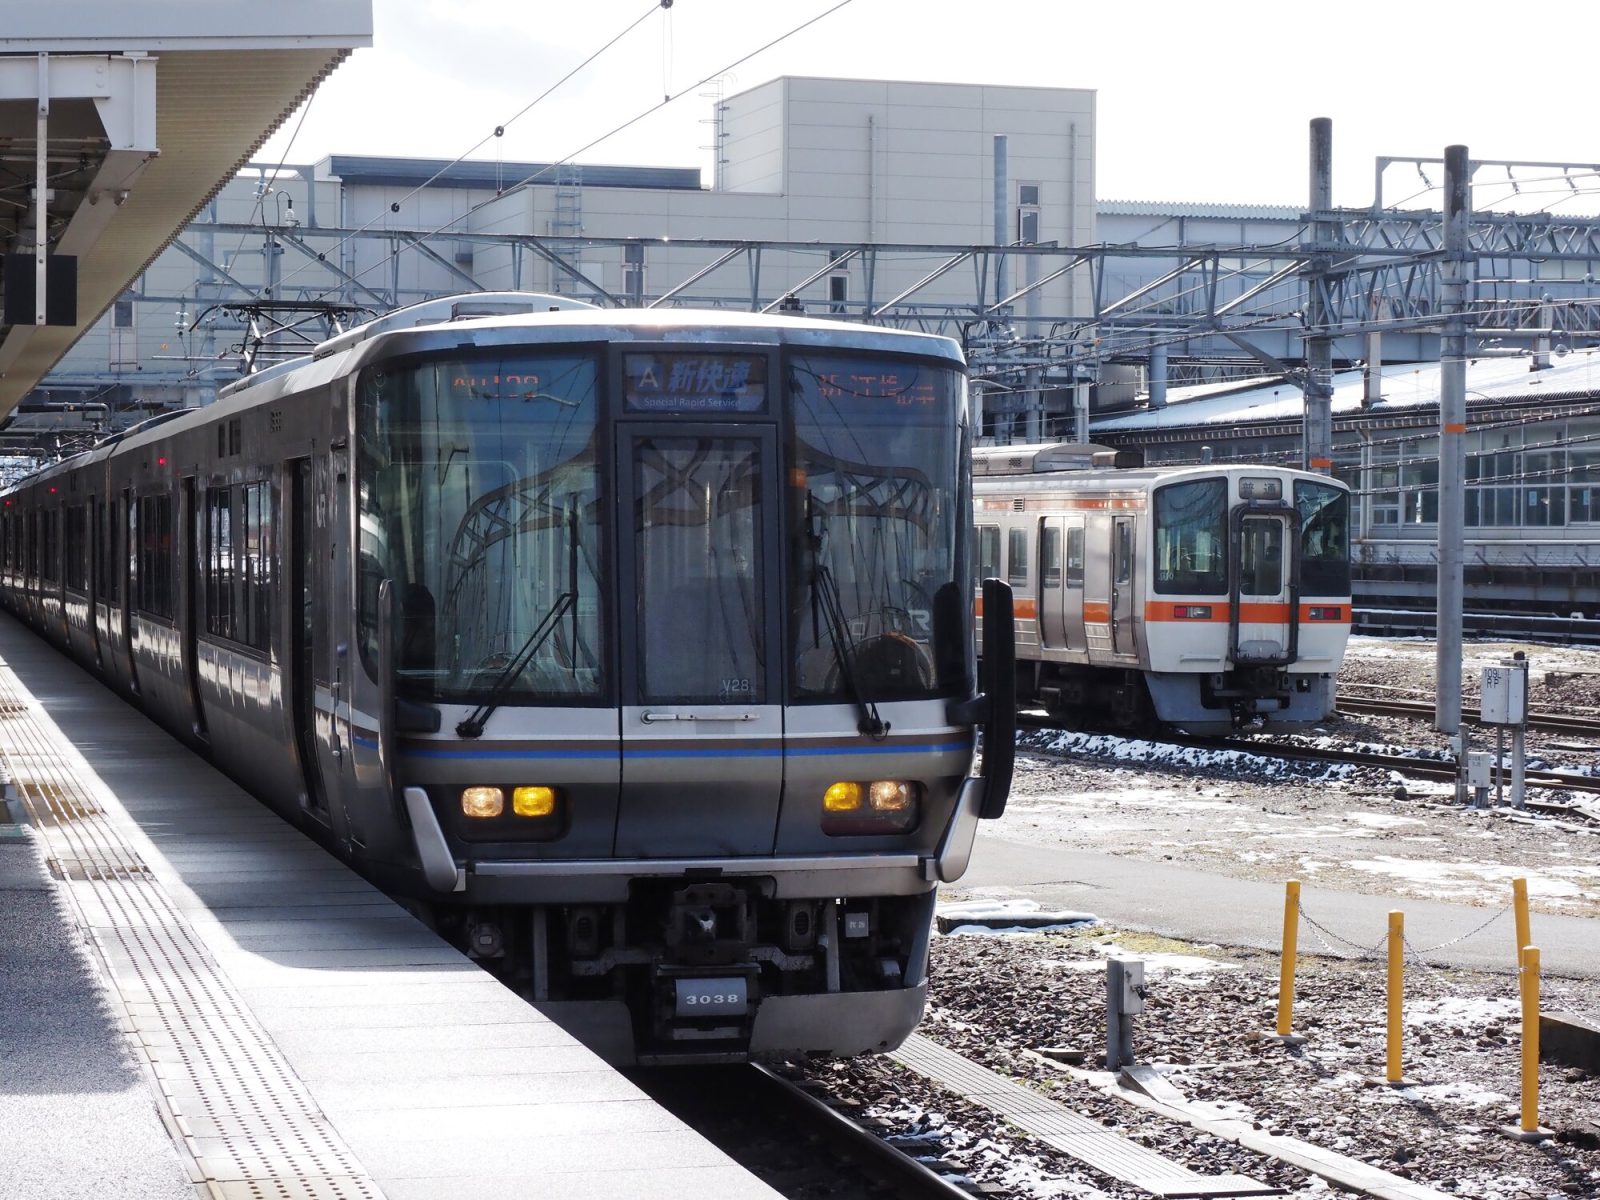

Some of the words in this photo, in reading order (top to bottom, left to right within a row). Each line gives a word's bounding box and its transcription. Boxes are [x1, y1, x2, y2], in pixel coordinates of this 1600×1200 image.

[638, 367, 658, 388] A
[668, 360, 753, 393] 新快速
[644, 397, 677, 409] Special
[679, 397, 706, 409] Rapid
[708, 397, 741, 407] Service
[686, 994, 739, 1005] 3038
